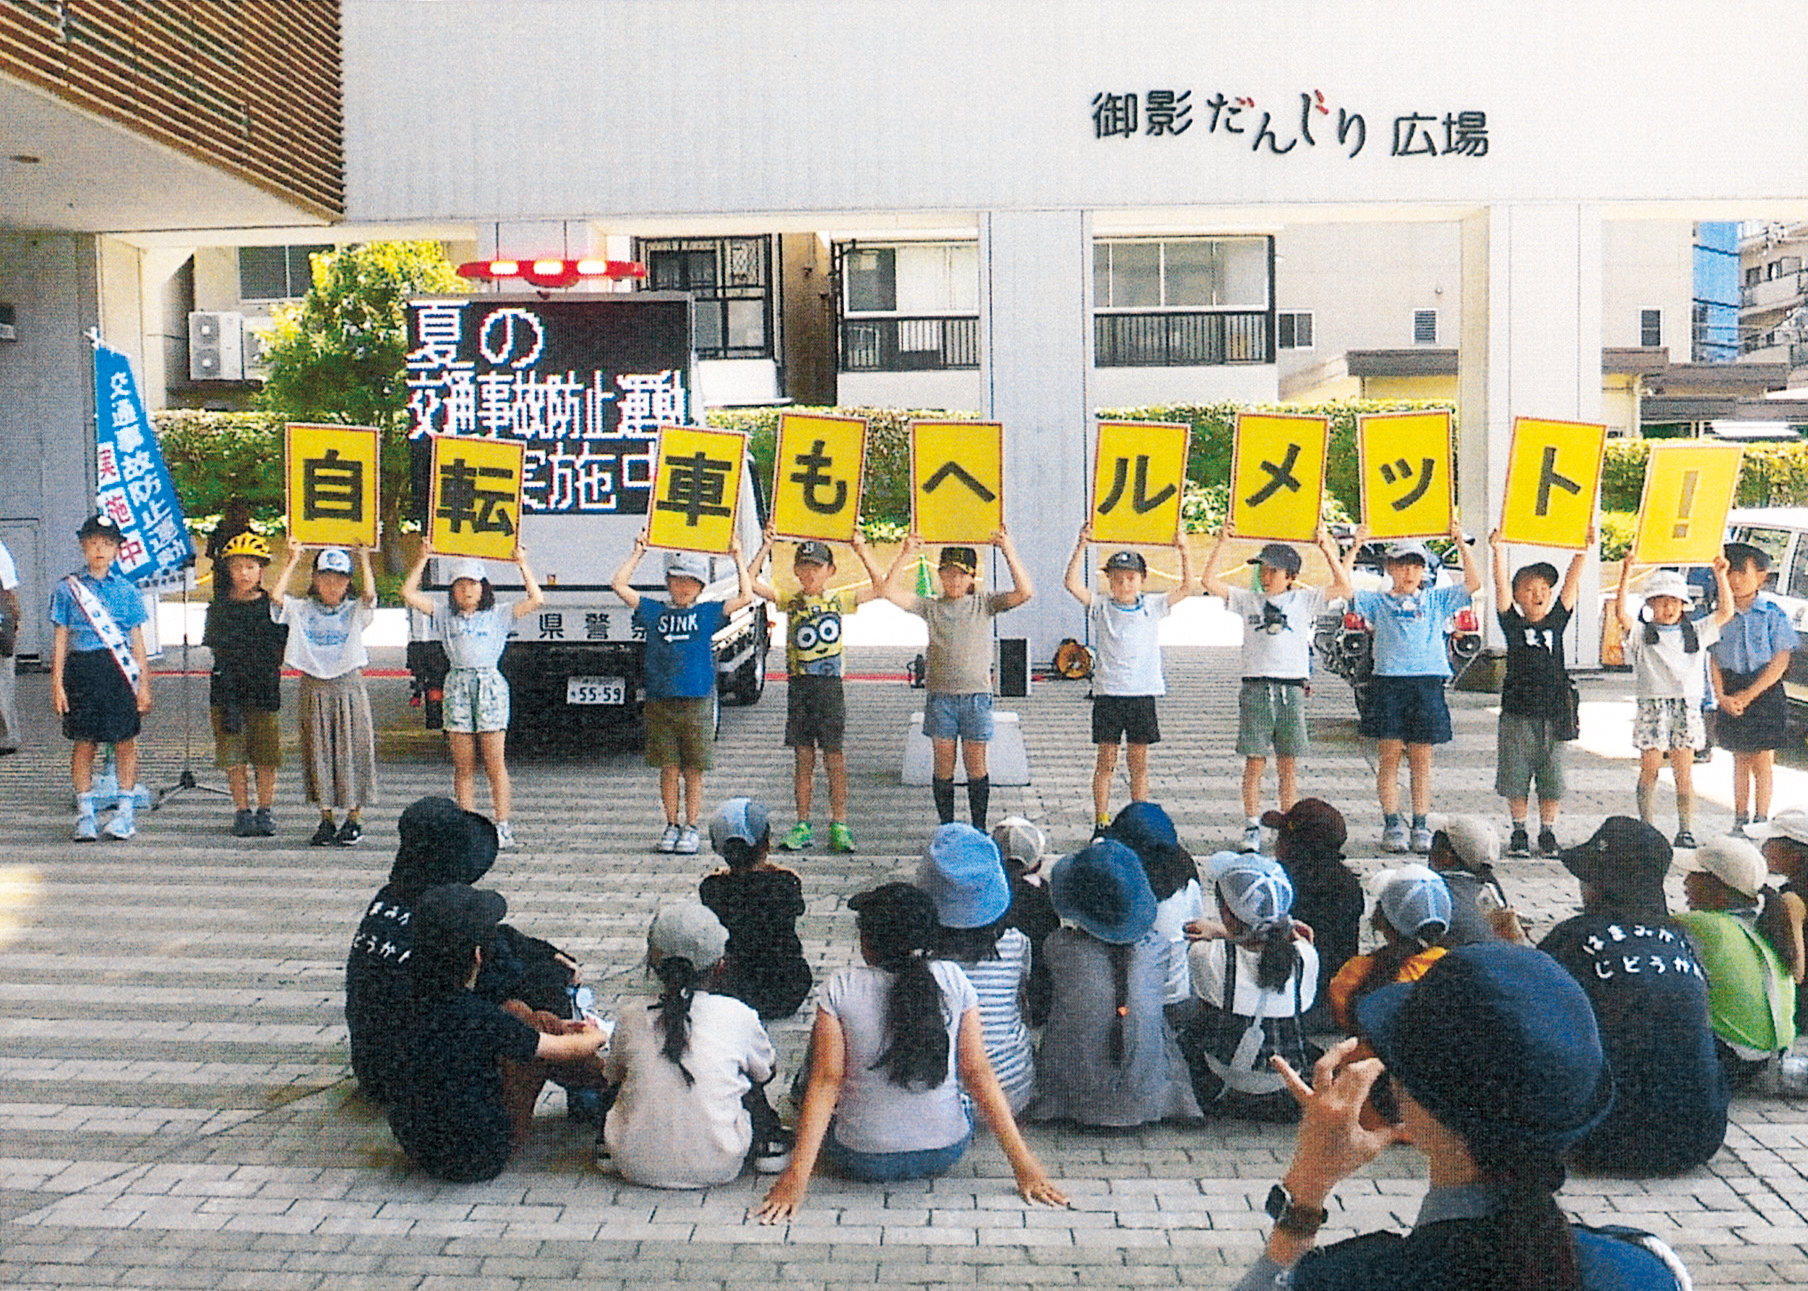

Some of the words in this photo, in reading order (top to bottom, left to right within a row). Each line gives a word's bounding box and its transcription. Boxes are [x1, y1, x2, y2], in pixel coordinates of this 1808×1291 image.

[406, 300, 544, 369] 夏の
[406, 369, 687, 440] 交通事故防止運動
[303, 448, 363, 522] 自
[435, 457, 516, 537] 転
[655, 451, 732, 527] 車
[790, 439, 848, 515] も
[1097, 454, 1178, 516] ル
[1244, 443, 1302, 508] メ
[1535, 446, 1582, 517] ト
[657, 612, 700, 634] SINK
